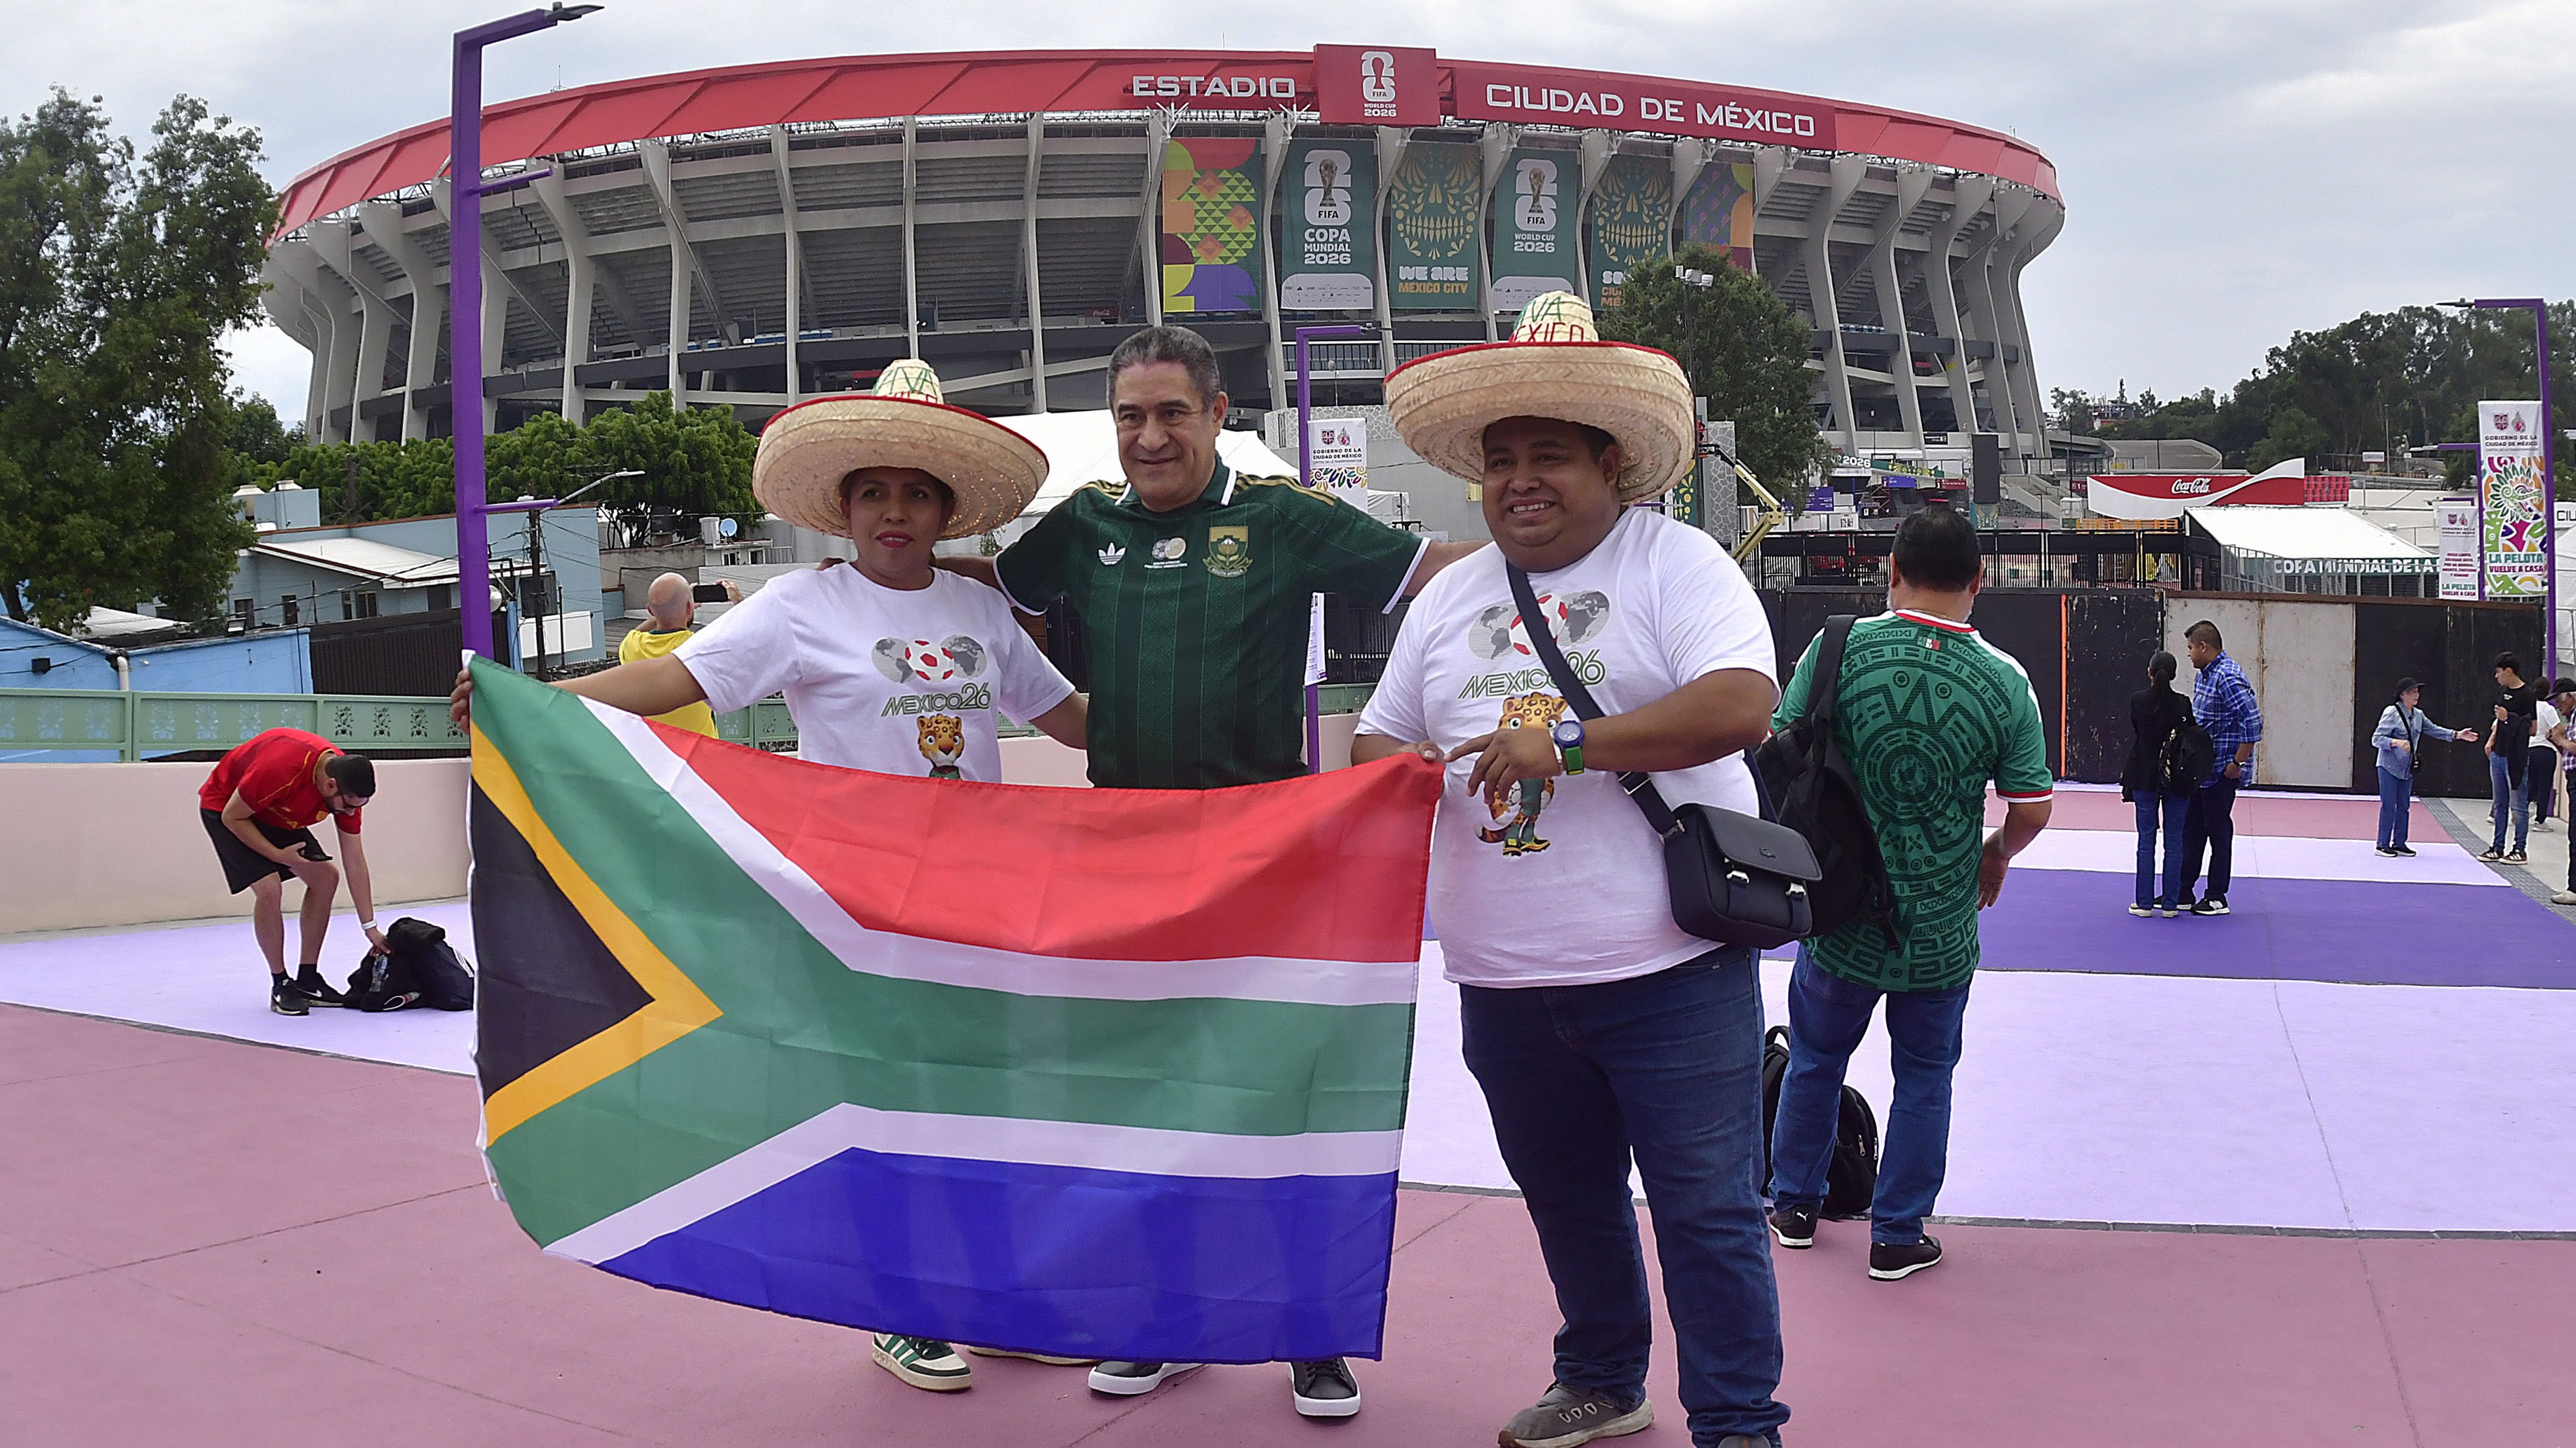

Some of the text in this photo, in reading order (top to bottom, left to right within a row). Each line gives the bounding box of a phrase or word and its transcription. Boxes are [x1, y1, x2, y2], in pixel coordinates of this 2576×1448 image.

[1133, 76, 1295, 98] ESTADIO
[1363, 109, 1397, 117] 2026
[1486, 84, 1815, 137] CIUDAD DE MÉXICO
[1318, 210, 1339, 219] FIFA
[1304, 228, 1351, 242] COPA
[1304, 243, 1351, 252] MUNDIAL
[1514, 241, 1555, 253] 2026
[1304, 253, 1352, 264] 2026
[1399, 266, 1428, 281] WE
[1399, 283, 1468, 293] MEXICO CITY
[1843, 455, 1871, 468] 2026
[2171, 478, 2212, 494] Coca-Cola
[2489, 554, 2544, 563] LA PELOTA
[2274, 560, 2316, 574] COPA
[2320, 558, 2389, 573] MUNDIAL
[2392, 559, 2413, 573] DE
[2415, 559, 2434, 573] LA
